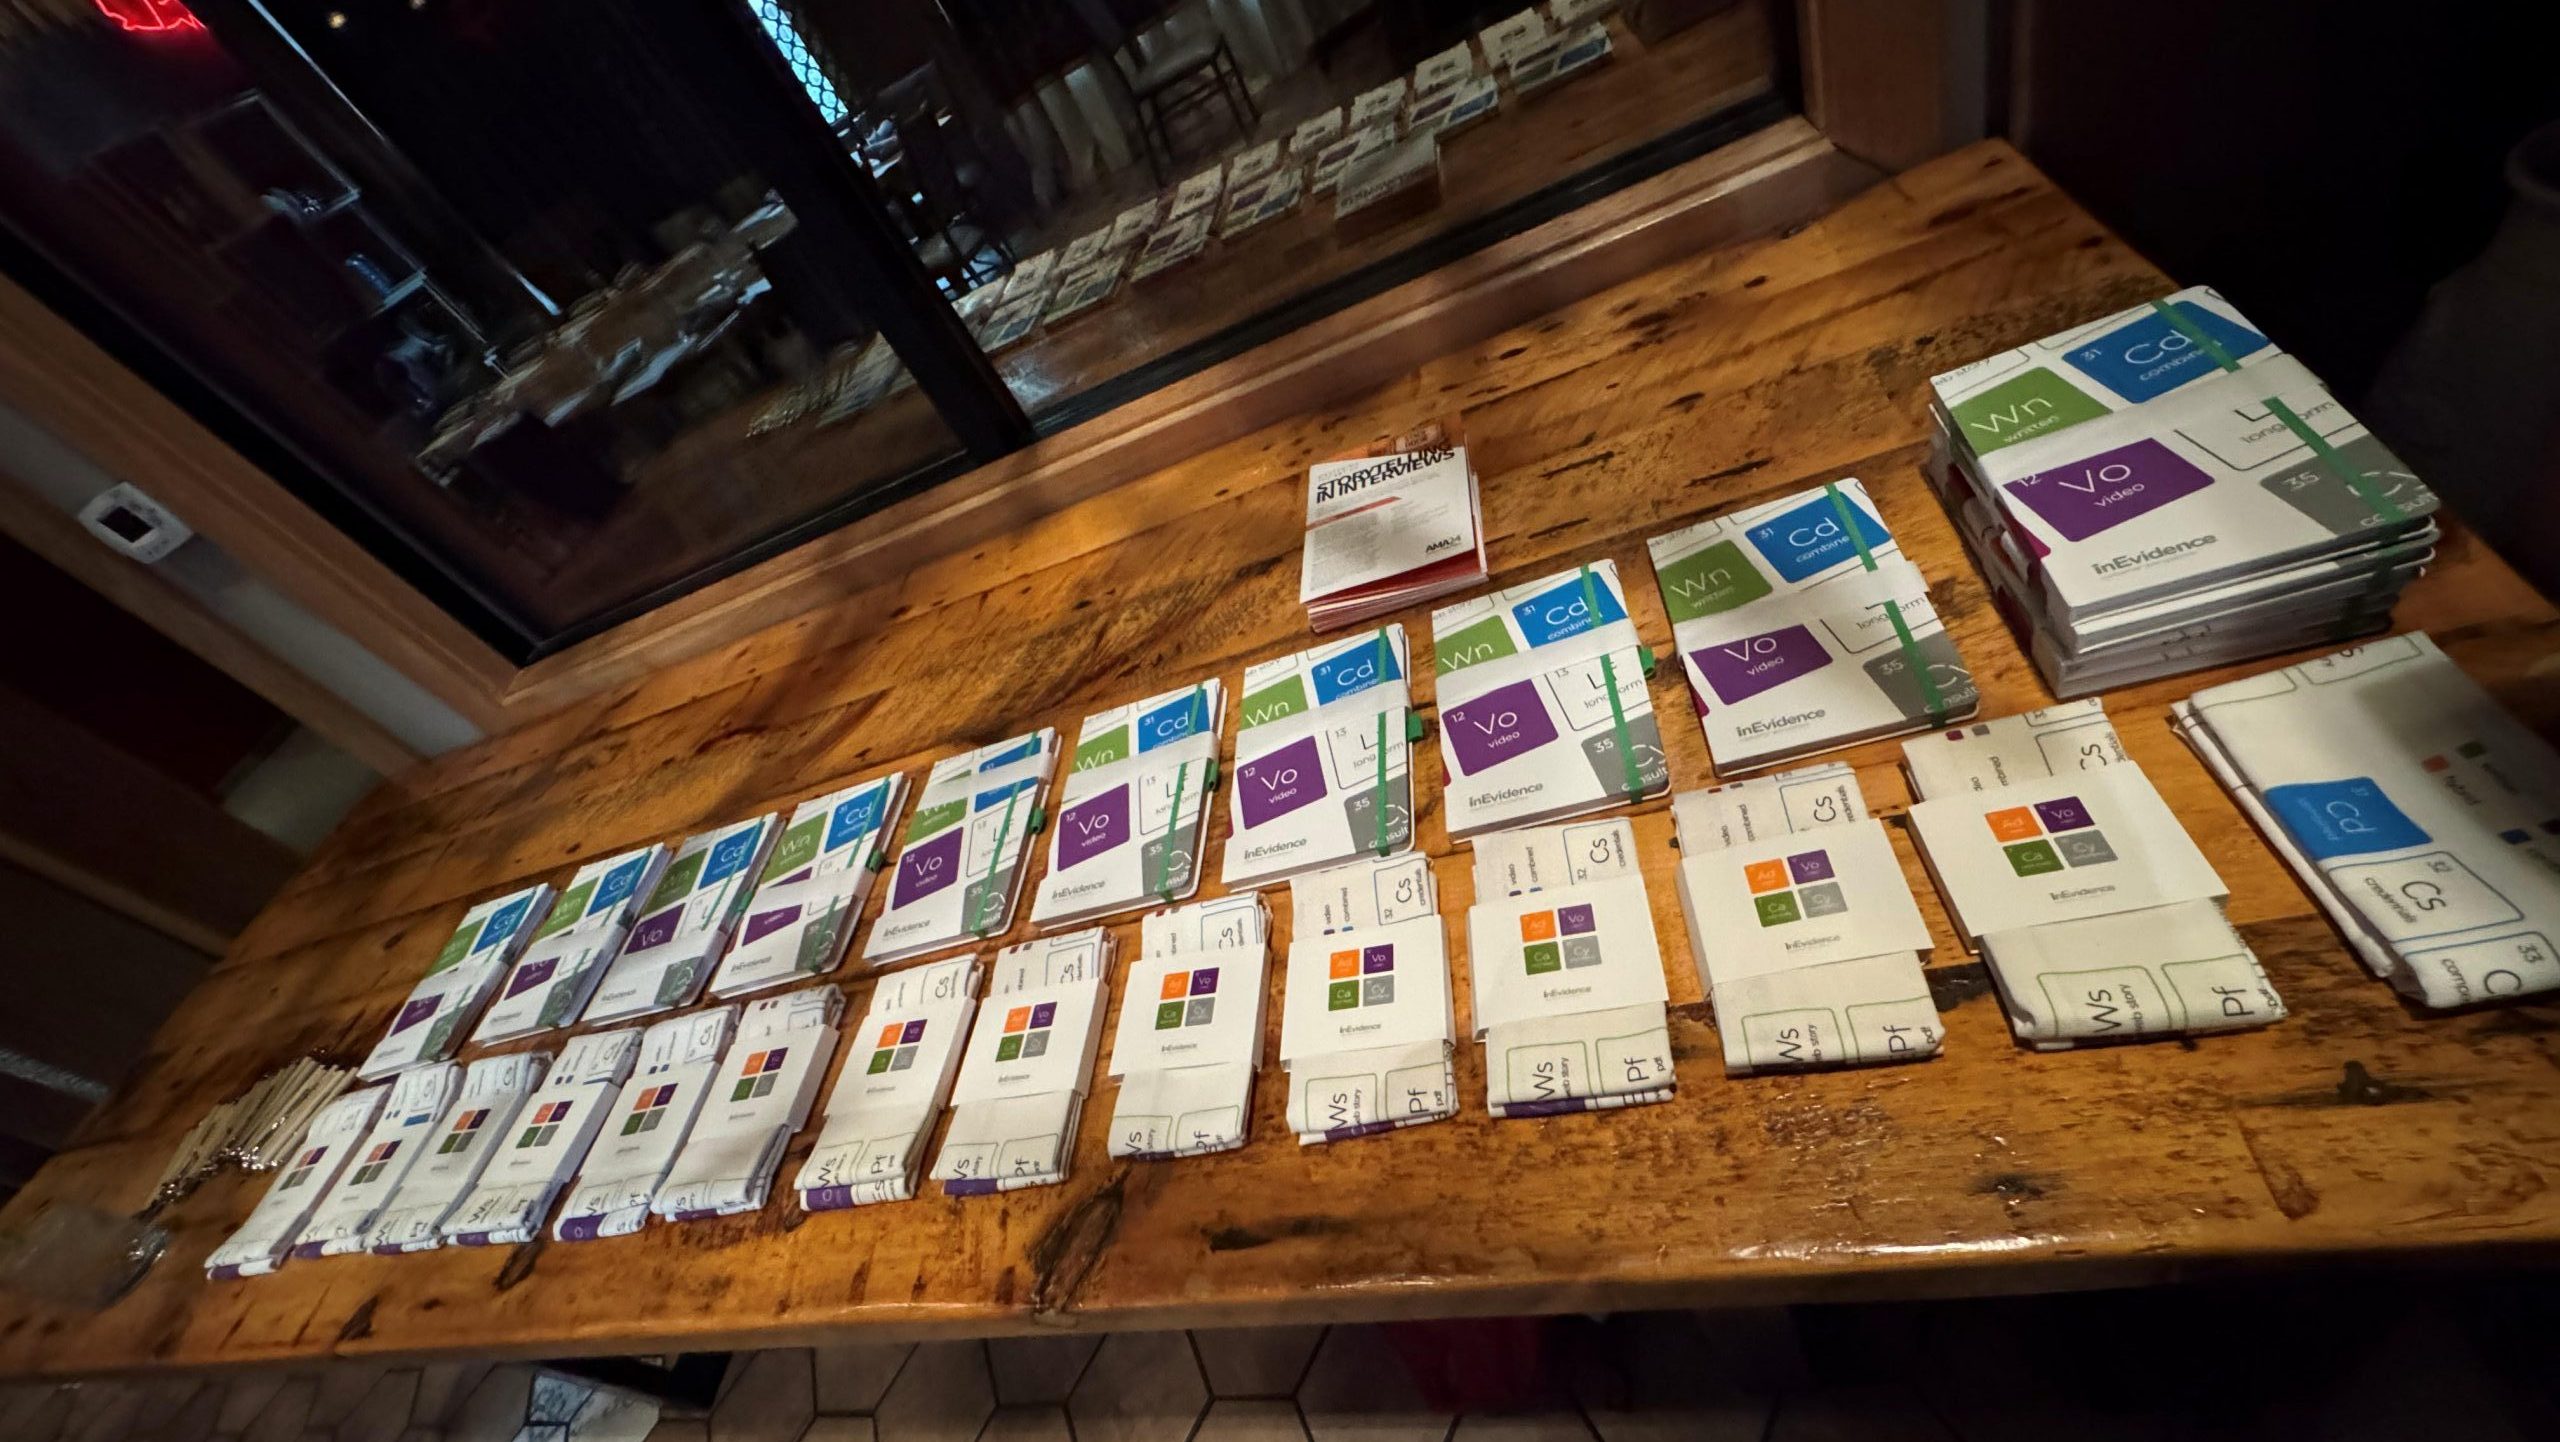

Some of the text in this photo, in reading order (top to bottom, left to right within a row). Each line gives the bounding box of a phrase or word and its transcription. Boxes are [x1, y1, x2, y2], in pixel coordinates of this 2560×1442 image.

[2080, 349, 2102, 361] 31
[2125, 330, 2193, 364] Cd
[1970, 398, 2052, 432] Wn
[1339, 452, 1455, 495] INTERVIEWS
[2017, 475, 2041, 488] 12
[2058, 465, 2131, 493] Vo
[2282, 471, 2320, 491] 35
[2094, 484, 2145, 507] video
[1426, 535, 1462, 552] AMA24
[1759, 526, 1775, 540] 31
[1788, 517, 1840, 547] Cd
[2091, 534, 2218, 575] inEvidence
[1670, 568, 1731, 597] Wn
[1522, 606, 1536, 616] 31
[1546, 596, 1589, 625] Cd
[1442, 644, 1493, 669] Wn
[1724, 636, 1777, 663] Vo
[1320, 666, 1331, 676] 31
[1337, 659, 1374, 686] Cd
[1747, 656, 1784, 678] video
[1880, 660, 1904, 675] 35
[1157, 712, 1189, 736] Cd
[1246, 701, 1289, 726] Wn
[1451, 711, 1466, 723] 12
[1473, 711, 1518, 736] Vo
[1736, 708, 1826, 739] inEvidence
[1488, 730, 1520, 748] video
[1593, 738, 1614, 753] 35
[1077, 750, 1114, 771] Wn
[1244, 766, 1257, 778] 12
[1260, 769, 1298, 791] Vo
[1268, 787, 1297, 804] video
[1353, 797, 1370, 811] 35
[1469, 782, 1543, 808] inEvidence
[845, 802, 872, 824] Cd
[1065, 812, 1076, 822] 12
[1814, 796, 1836, 822] Cs
[2051, 809, 2074, 819] Vo
[2326, 801, 2377, 834] Cd
[1078, 814, 1109, 835] Vo
[1244, 837, 1307, 860] inEvidence
[1590, 838, 1609, 863] Cs
[916, 857, 942, 876] Vo
[1800, 862, 1819, 871] Vo
[1396, 878, 1412, 903] Cs
[2402, 881, 2447, 911] Cs
[1568, 915, 1584, 923] Vo
[2518, 943, 2545, 964] 33
[1337, 990, 1351, 998] Ca
[2211, 986, 2255, 1017] Pf
[2087, 989, 2122, 1033] Ws
[1883, 1025, 1915, 1052] Pf
[1624, 1058, 1650, 1082] Pf
[1654, 1057, 1666, 1071] pdf
[1532, 1062, 1555, 1100] Ws
[1328, 1093, 1348, 1129] Ws
[1408, 1088, 1429, 1113] Pf
